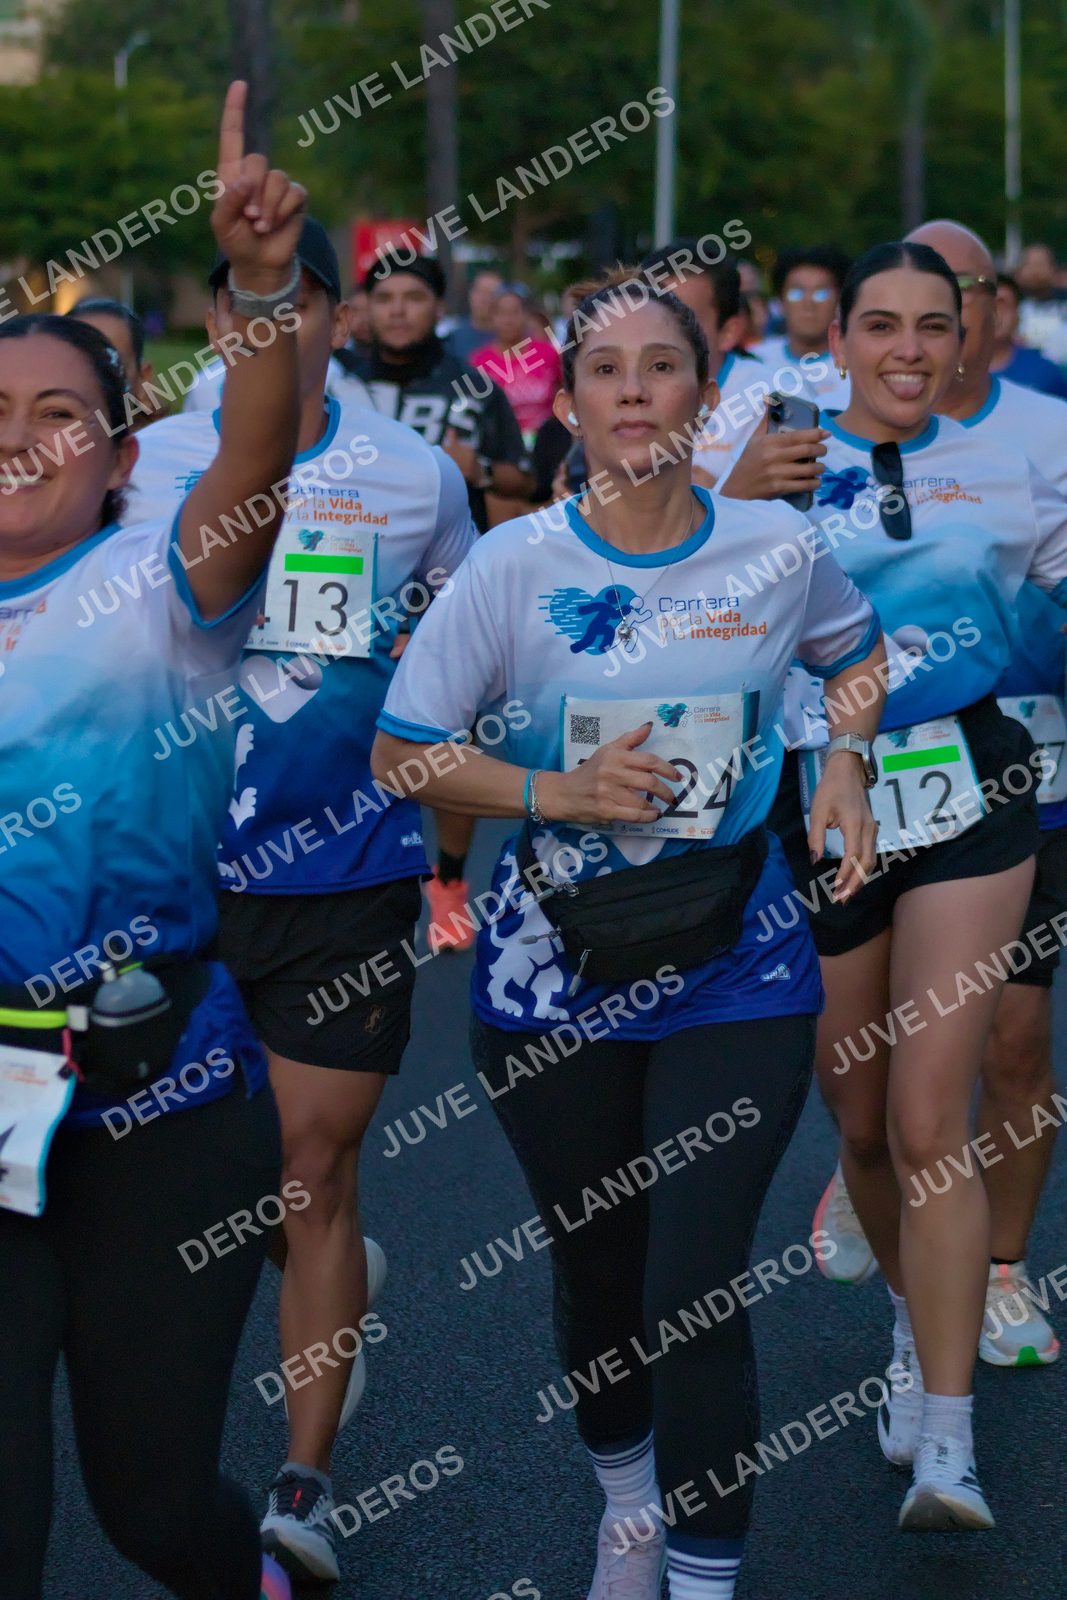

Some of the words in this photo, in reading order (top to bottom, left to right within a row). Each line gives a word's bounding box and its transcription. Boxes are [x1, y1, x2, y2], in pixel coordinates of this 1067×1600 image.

[902, 477, 956, 489] arrera
[314, 496, 325, 509] la
[329, 498, 362, 511] Vida
[313, 510, 388, 526] Integridad
[658, 596, 740, 612] Carrera
[689, 613, 702, 625] la
[706, 609, 741, 624] Vida
